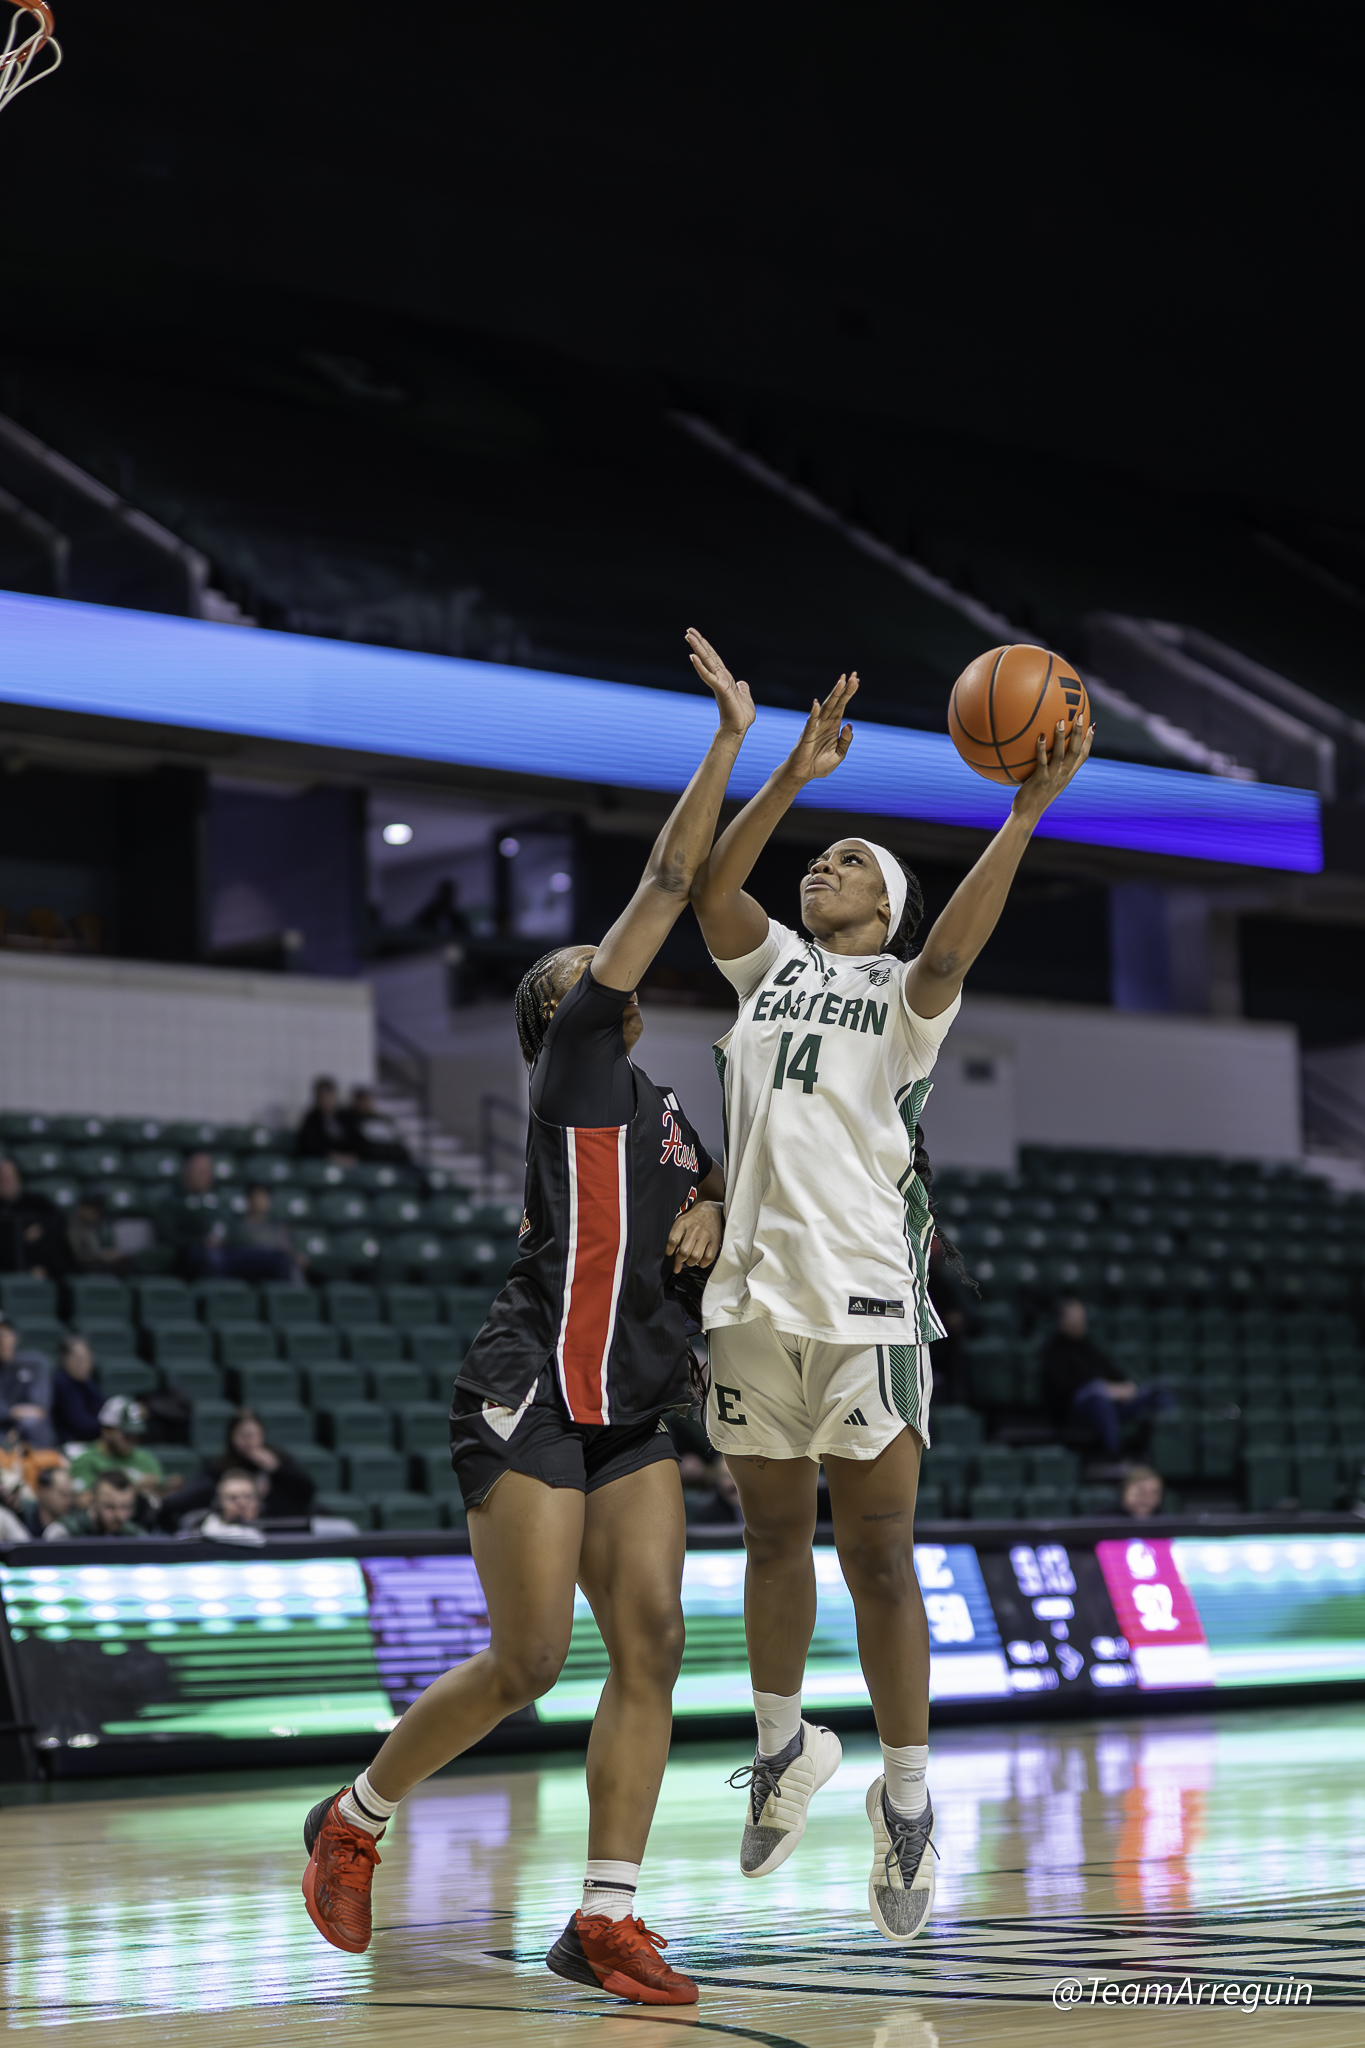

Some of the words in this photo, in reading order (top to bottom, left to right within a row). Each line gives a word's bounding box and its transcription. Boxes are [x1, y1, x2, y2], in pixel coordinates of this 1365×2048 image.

[773, 958, 808, 987] C
[752, 989, 889, 1036] EASTERN
[772, 1031, 823, 1095] 14
[715, 1382, 748, 1426] E
